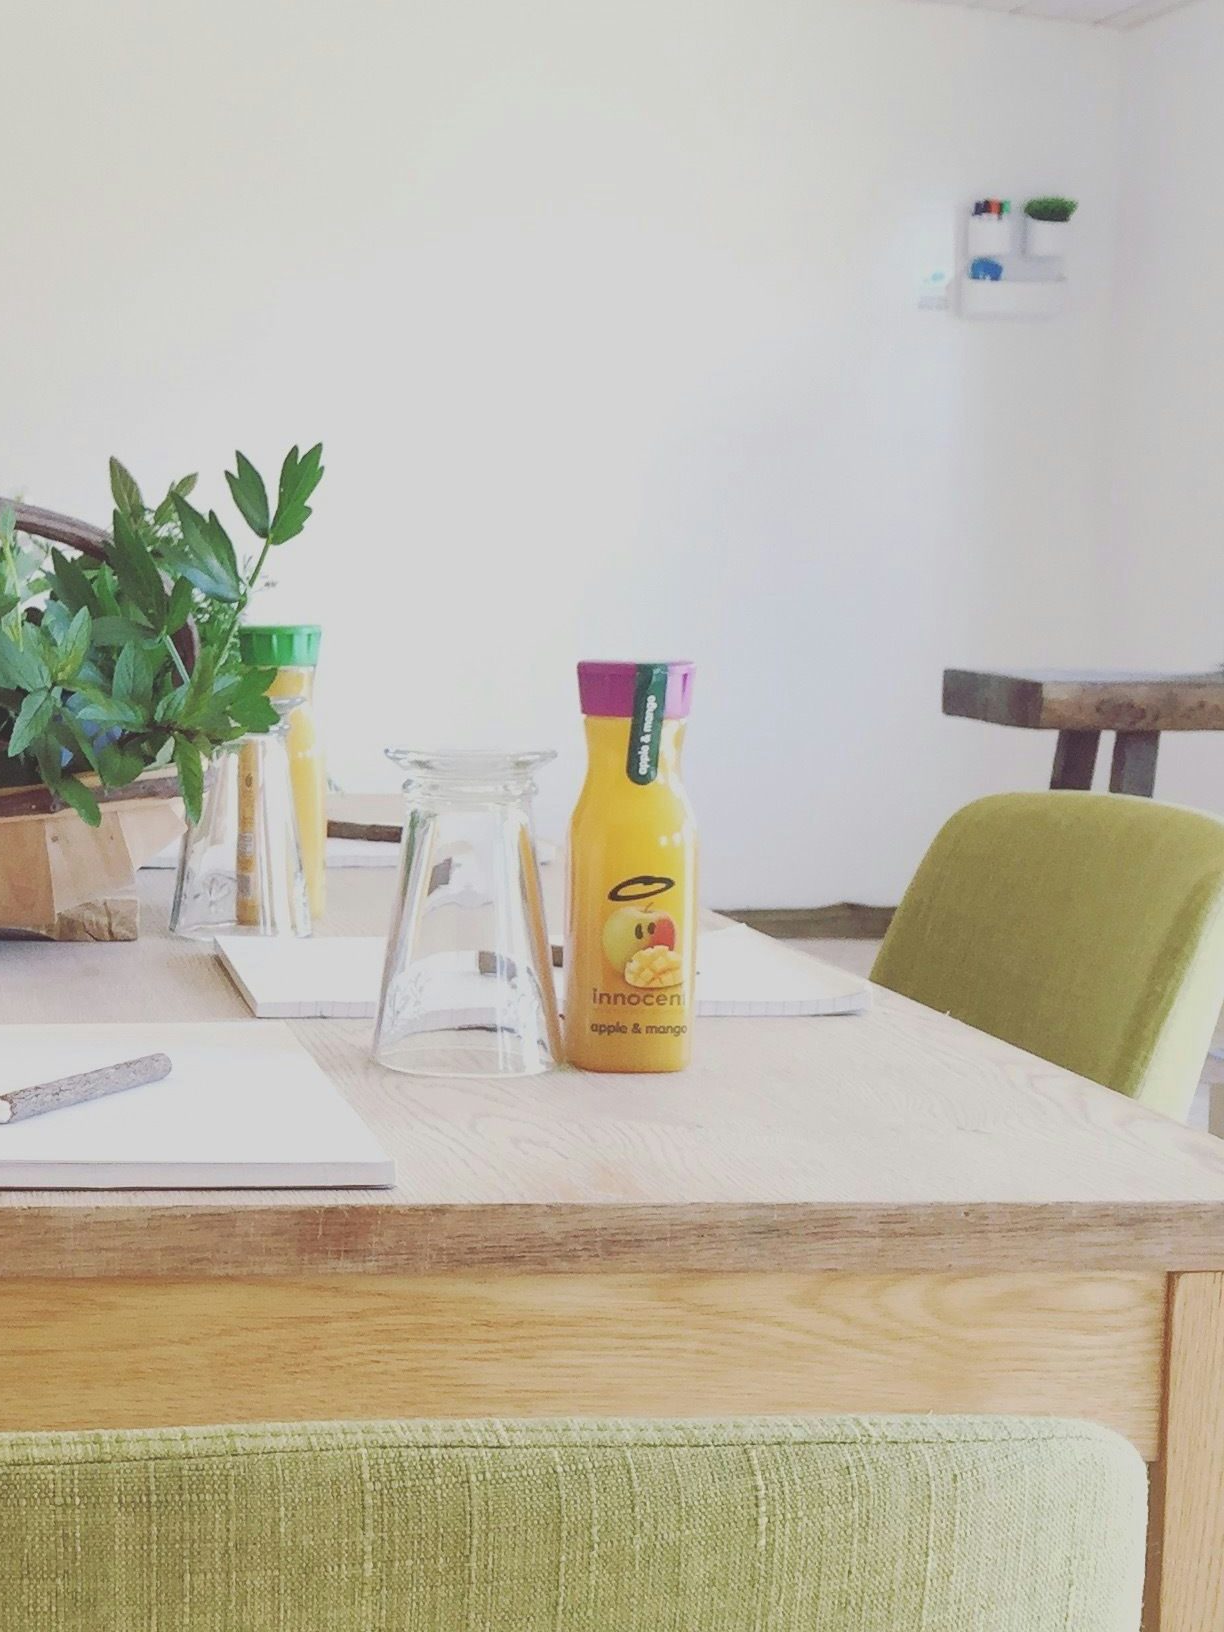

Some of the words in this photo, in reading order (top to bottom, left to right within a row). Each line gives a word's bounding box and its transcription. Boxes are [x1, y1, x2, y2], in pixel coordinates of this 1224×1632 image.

[643, 694, 658, 733] mango
[639, 733, 652, 744] &
[637, 744, 651, 776] apple
[590, 1022, 628, 1036] apple
[631, 1022, 642, 1034] &
[645, 1025, 688, 1038] mango
